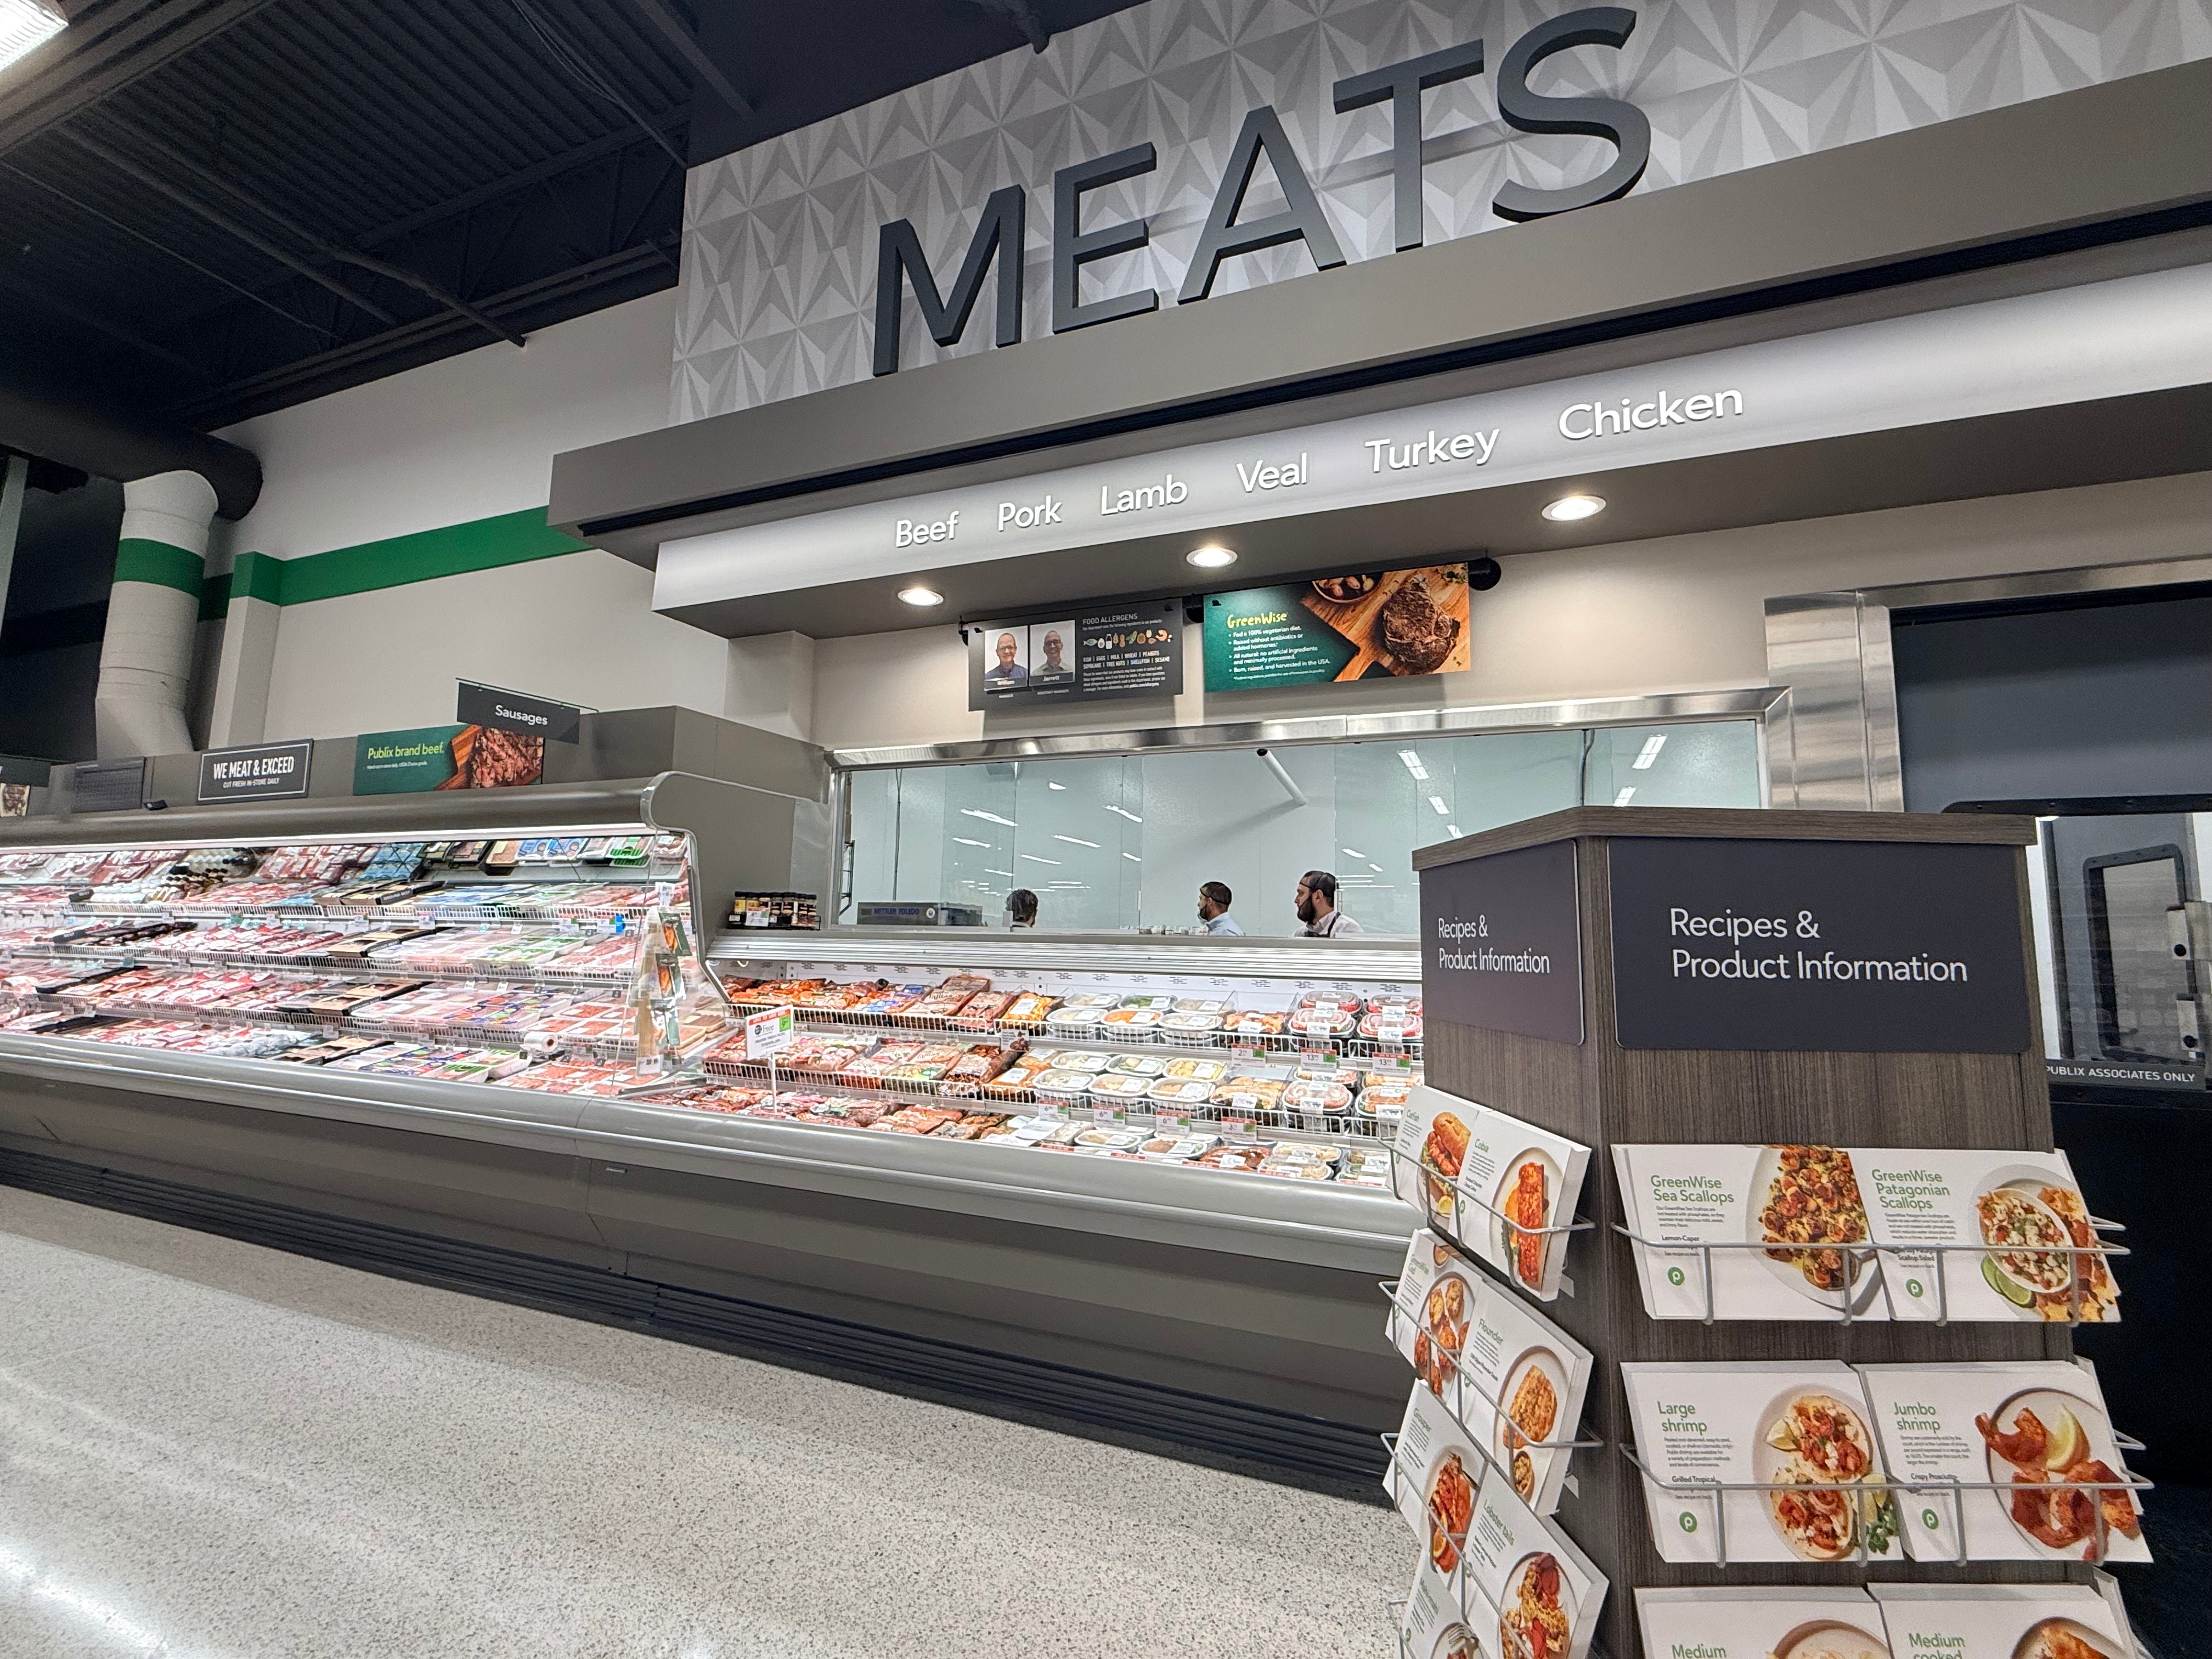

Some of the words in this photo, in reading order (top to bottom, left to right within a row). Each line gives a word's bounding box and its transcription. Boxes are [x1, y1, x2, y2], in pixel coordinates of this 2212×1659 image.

[873, 6, 1650, 377] MEATS
[894, 510, 959, 548] Beef
[997, 495, 1062, 533] Pork
[1100, 476, 1187, 516] Lamb
[1237, 455, 1308, 494] Veal
[1365, 428, 1500, 475] Turkey
[1559, 388, 1743, 443] Chicken
[1101, 613, 1138, 623] ALLERGENS
[1227, 612, 1288, 629] GreenWise
[495, 704, 548, 726] Sausages
[368, 746, 393, 759] Publix
[395, 743, 421, 757] brand
[213, 762, 228, 780] WE
[228, 760, 253, 778] MEAT
[253, 759, 260, 776] &
[262, 756, 295, 775] EXCEED
[1438, 916, 1476, 943] Recipes
[1479, 915, 1488, 938] &
[1670, 907, 1787, 945] Recipes
[1796, 910, 1820, 939] &
[1439, 947, 1477, 972] Product
[1479, 948, 1549, 973] Information
[1673, 949, 1791, 979] Product
[1798, 951, 1966, 981] Information
[2046, 1065, 2085, 1076] PUBLIX
[2089, 1069, 2160, 1081] ASSOCIATES
[2163, 1072, 2195, 1082] ONLY
[1650, 1175, 1722, 1189] GreenWise
[1872, 1169, 1943, 1182] GreenWise
[1654, 1189, 1678, 1201] Sea
[1680, 1189, 1734, 1206] Scallops
[1875, 1182, 1950, 1198] Patagonian
[1880, 1196, 1933, 1212] Scallops
[1898, 1254, 1918, 1262] Scallop
[1479, 1318, 1503, 1345] Flounder
[1657, 1401, 1695, 1418] Large
[1894, 1402, 1936, 1415] Jumbo
[1662, 1418, 1707, 1436] shrimp
[1897, 1417, 1940, 1434] shrimp
[1692, 1475, 1716, 1484] Tropical
[1484, 1499, 1503, 1530] Lobster
[1908, 1633, 1966, 1647] Medium
[1672, 1643, 1726, 1659] Medium
